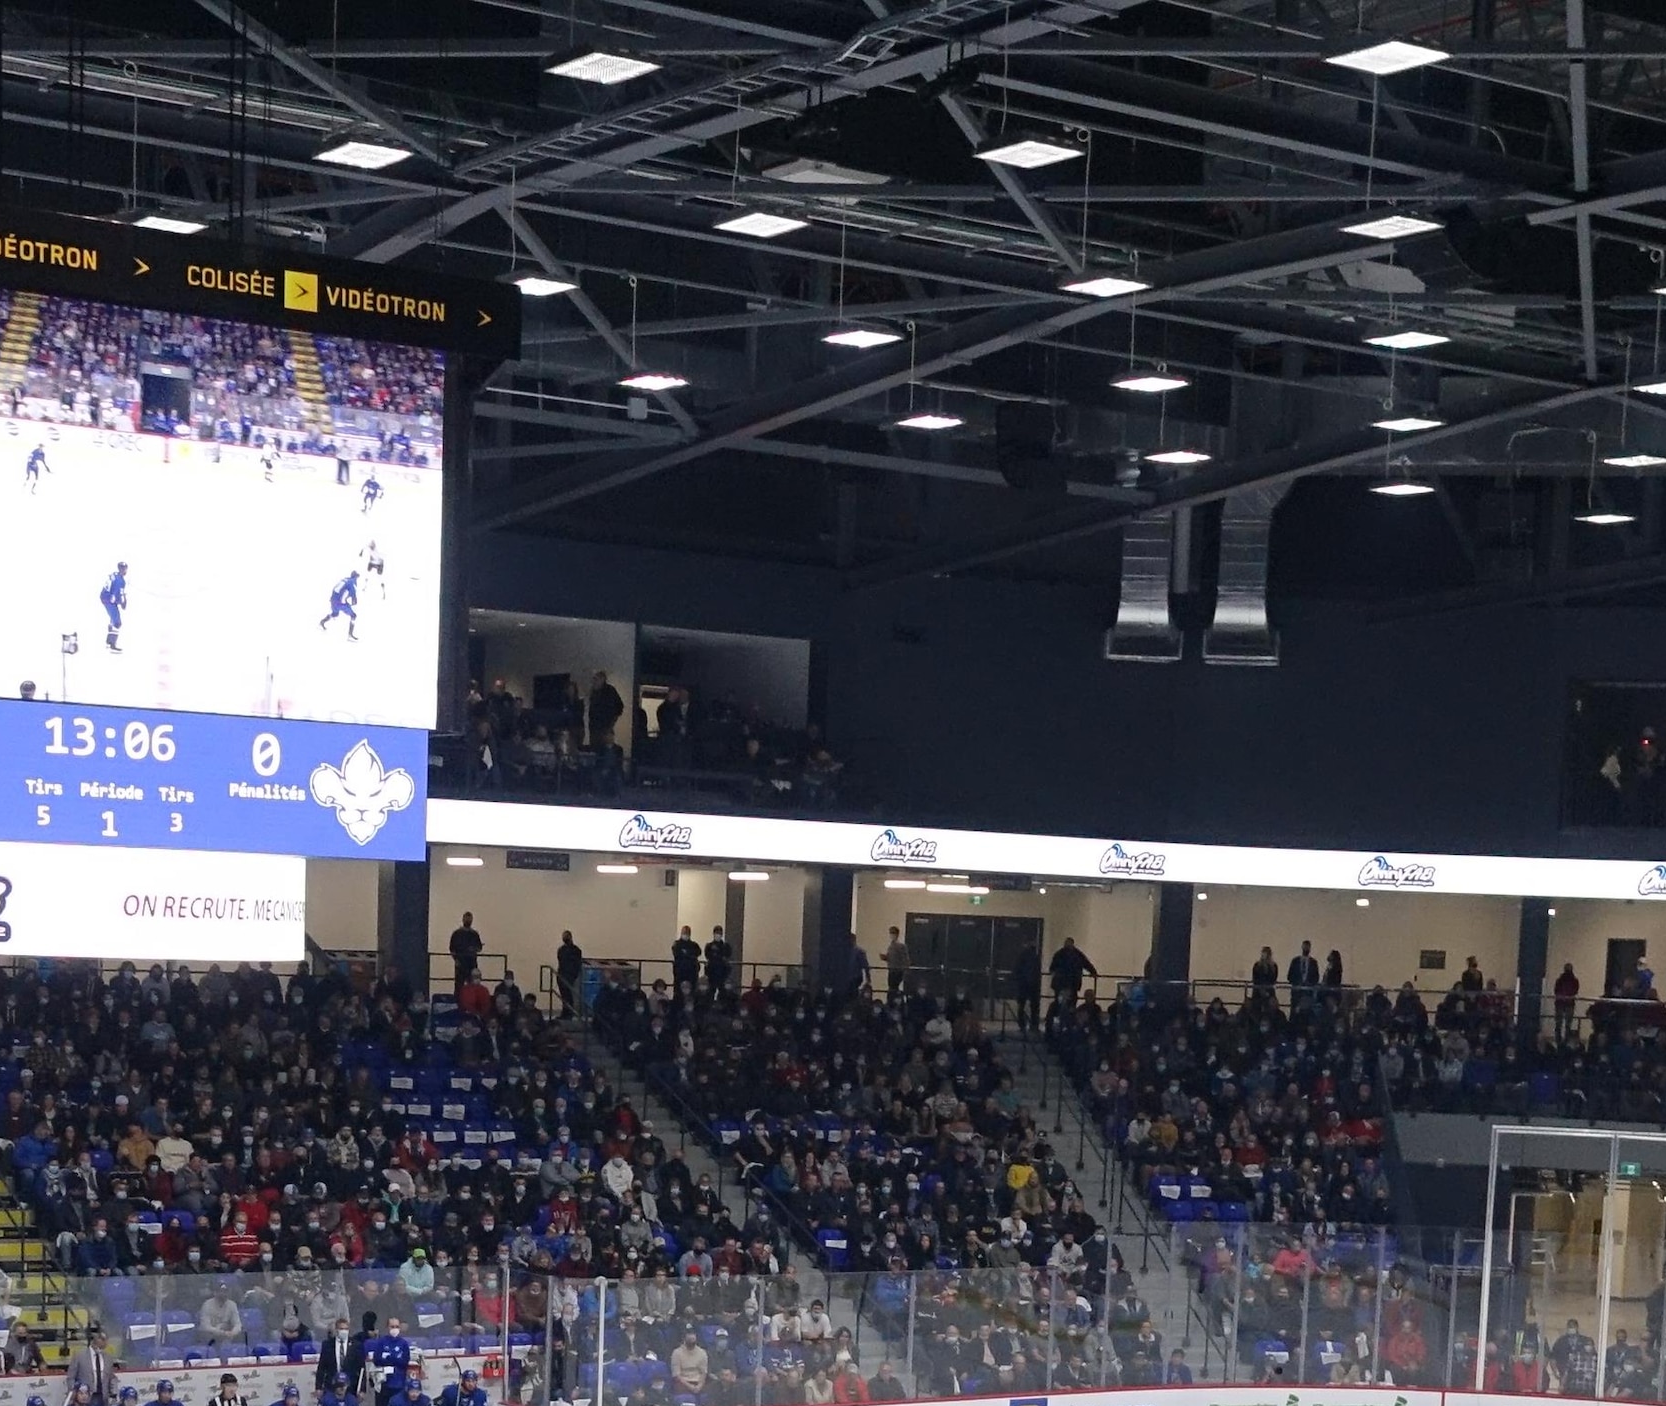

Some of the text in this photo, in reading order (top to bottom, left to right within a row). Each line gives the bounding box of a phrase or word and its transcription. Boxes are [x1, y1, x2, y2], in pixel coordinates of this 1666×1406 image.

[187, 264, 446, 324] COLISÉE VIDÉOTRON
[44, 716, 176, 762] 13:06
[251, 732, 281, 777] 0
[25, 778, 195, 804] Tirs Période Tirs
[229, 781, 306, 802] Pénalités
[37, 805, 183, 837] 5 1 3
[124, 894, 157, 917] ON
[164, 895, 249, 920] RECRUTE.
